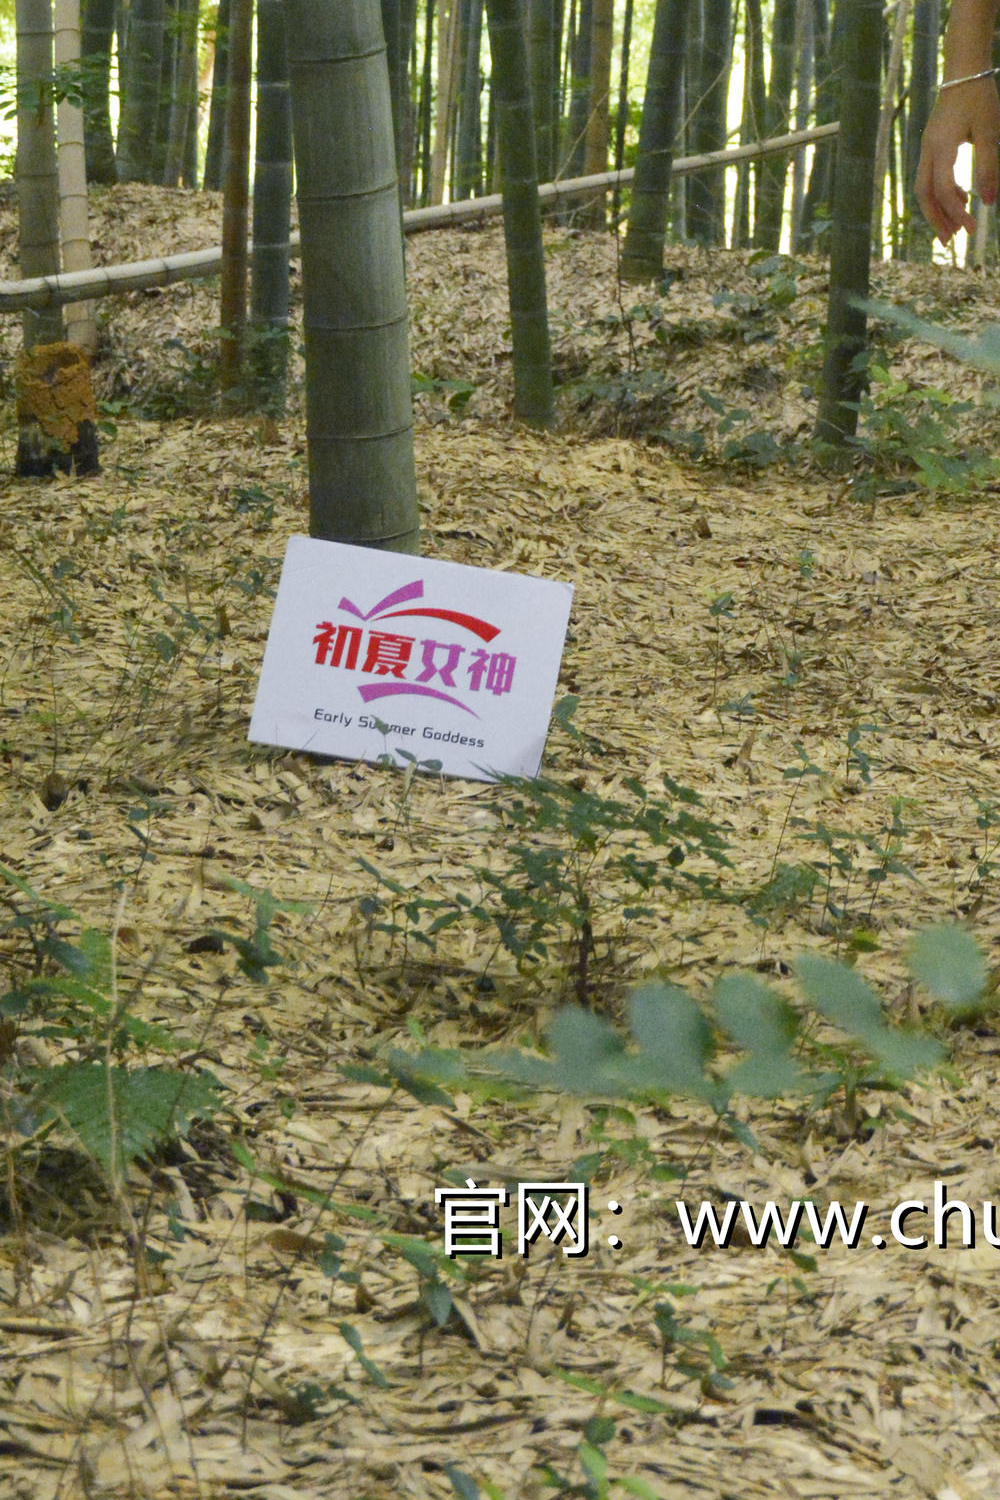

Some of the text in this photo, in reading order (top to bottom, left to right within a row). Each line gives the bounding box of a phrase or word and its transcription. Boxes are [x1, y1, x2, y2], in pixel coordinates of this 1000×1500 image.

[312, 621, 517, 696] 初夏女神
[314, 708, 486, 749] Early Sumer Goddess
